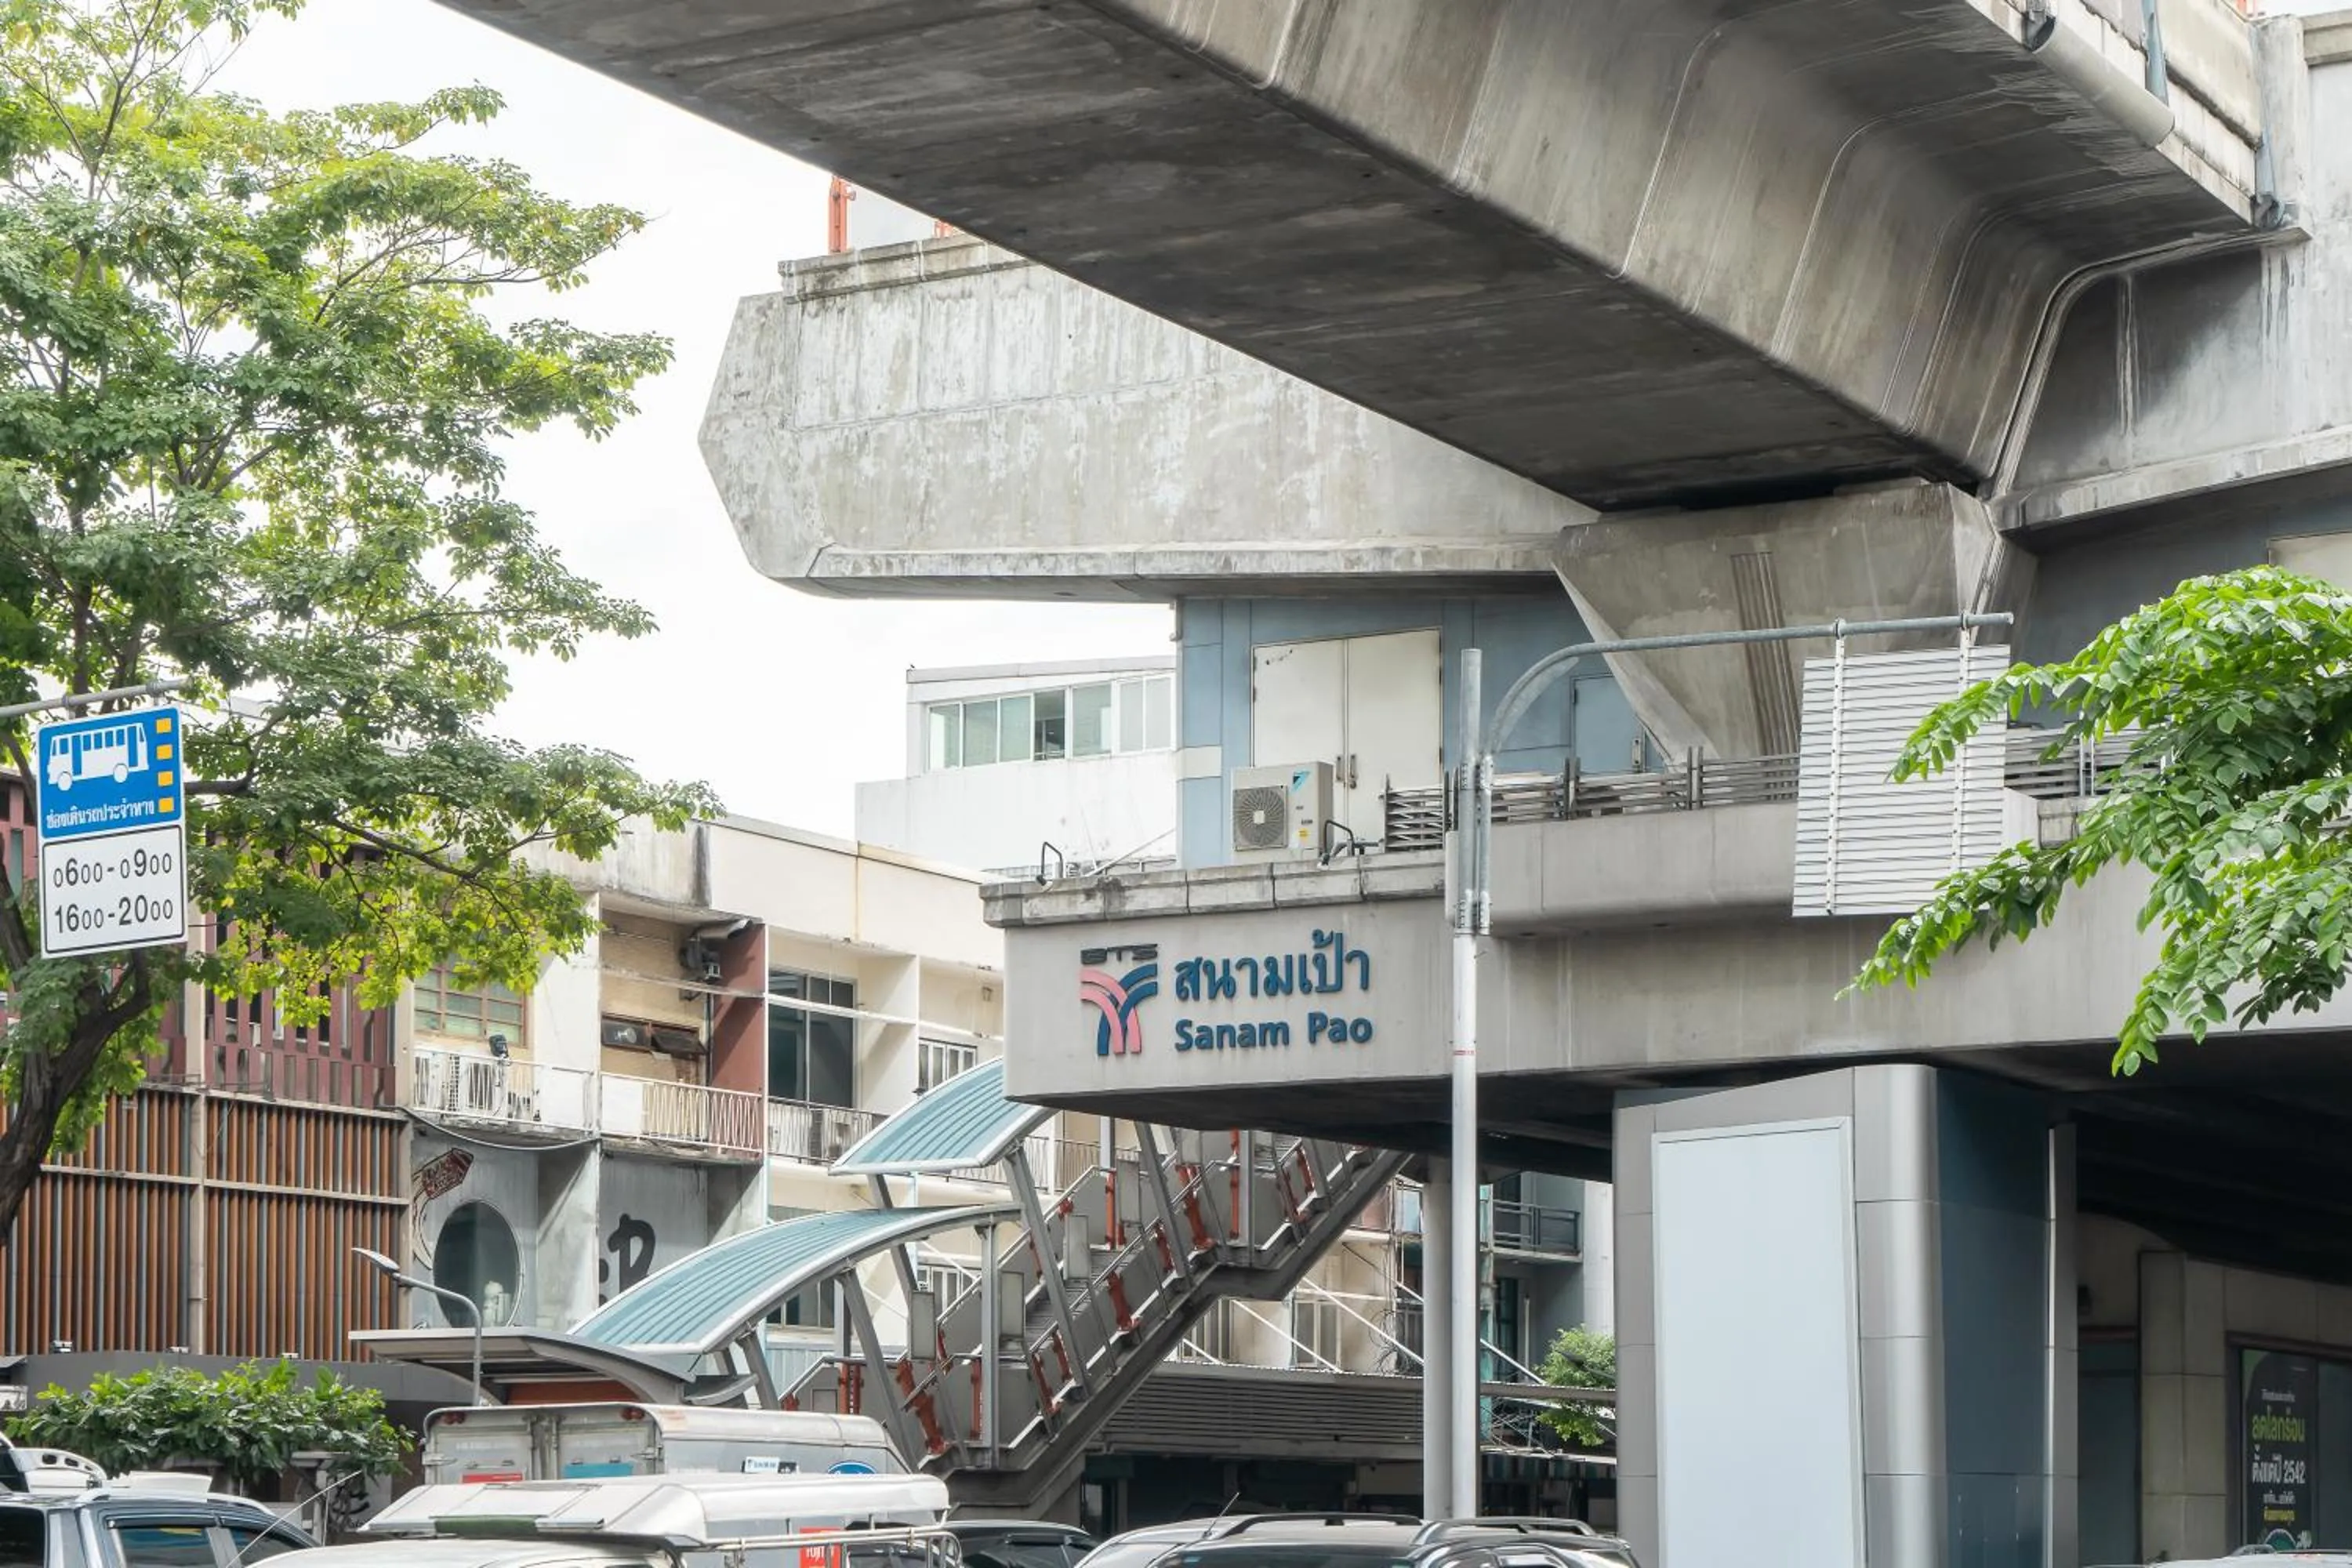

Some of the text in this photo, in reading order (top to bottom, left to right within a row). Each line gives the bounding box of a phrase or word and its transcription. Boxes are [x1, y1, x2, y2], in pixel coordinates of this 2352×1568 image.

[47, 798, 154, 829] ช่องเดินรถประจำทาง
[1081, 944, 1158, 965] BTS
[1174, 929, 1370, 1001] สนามเป้า
[1175, 1011, 1373, 1051] Sanam Pao
[2283, 1460, 2306, 1484] 2542
